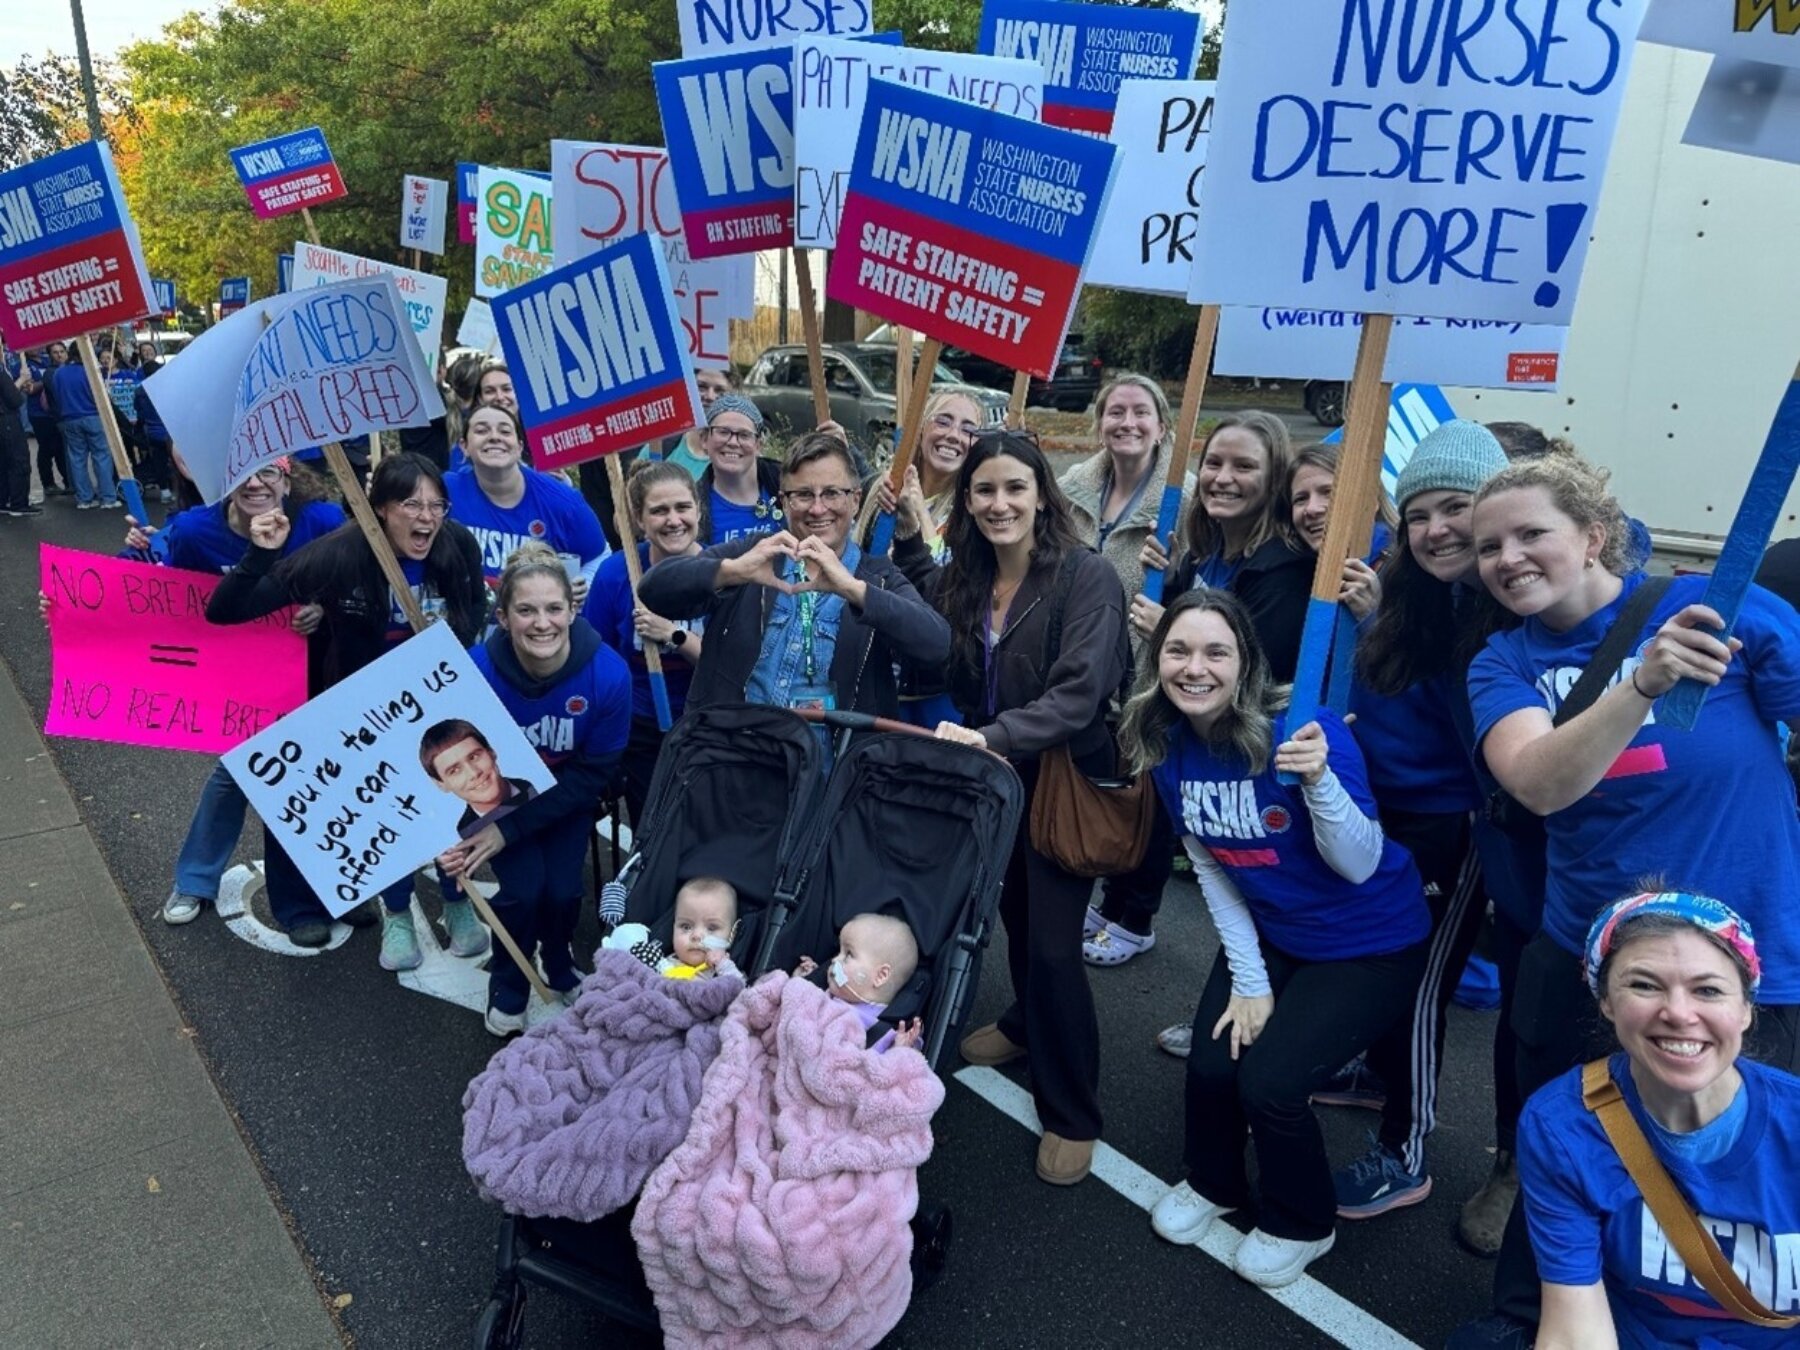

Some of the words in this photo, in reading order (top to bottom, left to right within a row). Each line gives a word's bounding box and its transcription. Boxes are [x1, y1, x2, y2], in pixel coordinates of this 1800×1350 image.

[694, 0, 868, 44] NURSES
[1086, 26, 1173, 55] WASHINGTON
[994, 18, 1077, 88] WSNA
[1081, 49, 1120, 72] STATE
[1119, 53, 1179, 78] NURSES
[1331, 0, 1622, 96] NURSES
[679, 63, 794, 196] WS
[1250, 93, 1593, 185] DESERVE
[32, 164, 92, 199] WASHINGTON
[240, 147, 285, 179] WSNA
[871, 107, 972, 205] WSNA
[982, 137, 1082, 187] WASHINGTON
[38, 193, 66, 217] STATE
[63, 181, 104, 209] NURSES
[258, 186, 281, 200] SAFE
[281, 174, 321, 193] STAFFING
[266, 192, 301, 211] PATIENT
[301, 183, 332, 199] SAFETY
[968, 187, 1067, 237] ASSOCIATION
[975, 163, 1017, 191] STATE
[1017, 176, 1088, 216] NURSES
[0, 187, 43, 249] SNA
[44, 201, 103, 234] ASSOCIATION
[706, 221, 725, 243] RN
[724, 214, 782, 240] STAFFING
[304, 247, 350, 277] Seattle
[860, 222, 912, 264] SAFE
[914, 240, 1018, 304] STAFFING
[1302, 199, 1588, 309] MORE!
[4, 276, 39, 305] SAFE
[37, 256, 103, 292] STAFFING
[16, 295, 71, 330] PATIENT
[71, 280, 123, 313] SAFETY
[858, 258, 944, 313] PATIENT
[945, 292, 1031, 344] SAFETY
[293, 291, 398, 368] NEEDS
[505, 253, 665, 413] WSNA
[269, 370, 312, 394] OVER
[319, 364, 419, 435] GREED
[555, 423, 594, 452] STAFFING
[606, 407, 644, 436] PATIENT
[643, 396, 676, 424] SAFETY
[51, 562, 104, 610] NO
[62, 678, 111, 720] NO
[128, 688, 203, 733] REAL
[222, 699, 288, 739] BRE
[520, 715, 574, 752] SNA
[248, 740, 303, 787] So
[277, 757, 342, 835] you're
[341, 690, 424, 751] telling
[317, 805, 362, 860] you
[356, 761, 400, 804] can
[1180, 779, 1266, 839] WSNA
[336, 822, 401, 902] afford
[391, 793, 421, 821] it
